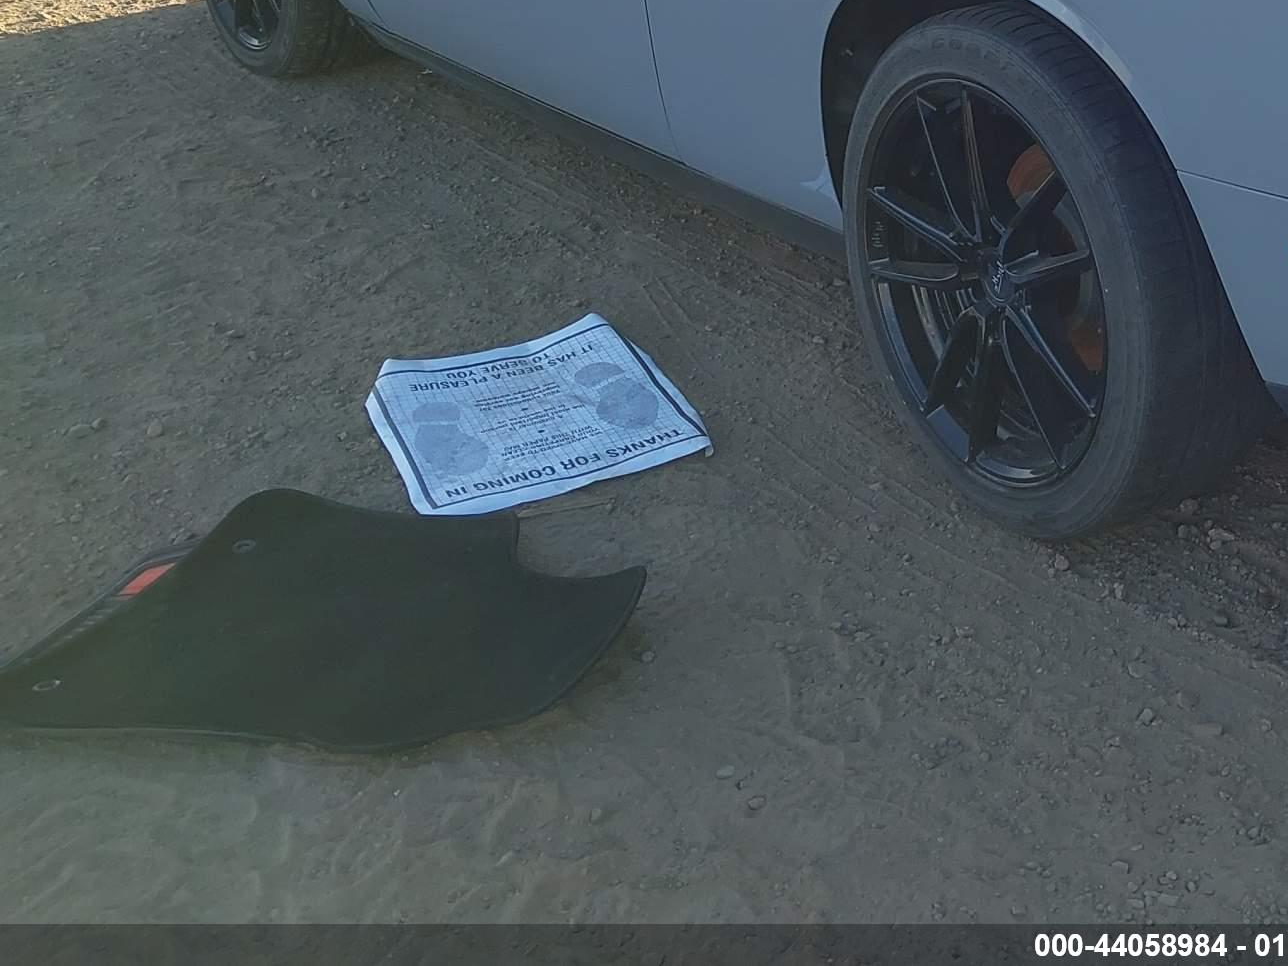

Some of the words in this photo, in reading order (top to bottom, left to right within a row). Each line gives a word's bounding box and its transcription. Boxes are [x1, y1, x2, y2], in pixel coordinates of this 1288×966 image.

[577, 343, 594, 354] IT
[530, 352, 551, 363] TO
[545, 351, 577, 366] HAS
[479, 358, 528, 374] SERVE
[506, 364, 544, 377] BEEN
[445, 369, 477, 380] YOU
[489, 372, 503, 380] A
[407, 375, 488, 392] PLEASURE
[603, 428, 684, 458] THANKS
[558, 451, 601, 470] FOR
[471, 464, 557, 492] COMING
[444, 486, 468, 498] IN
